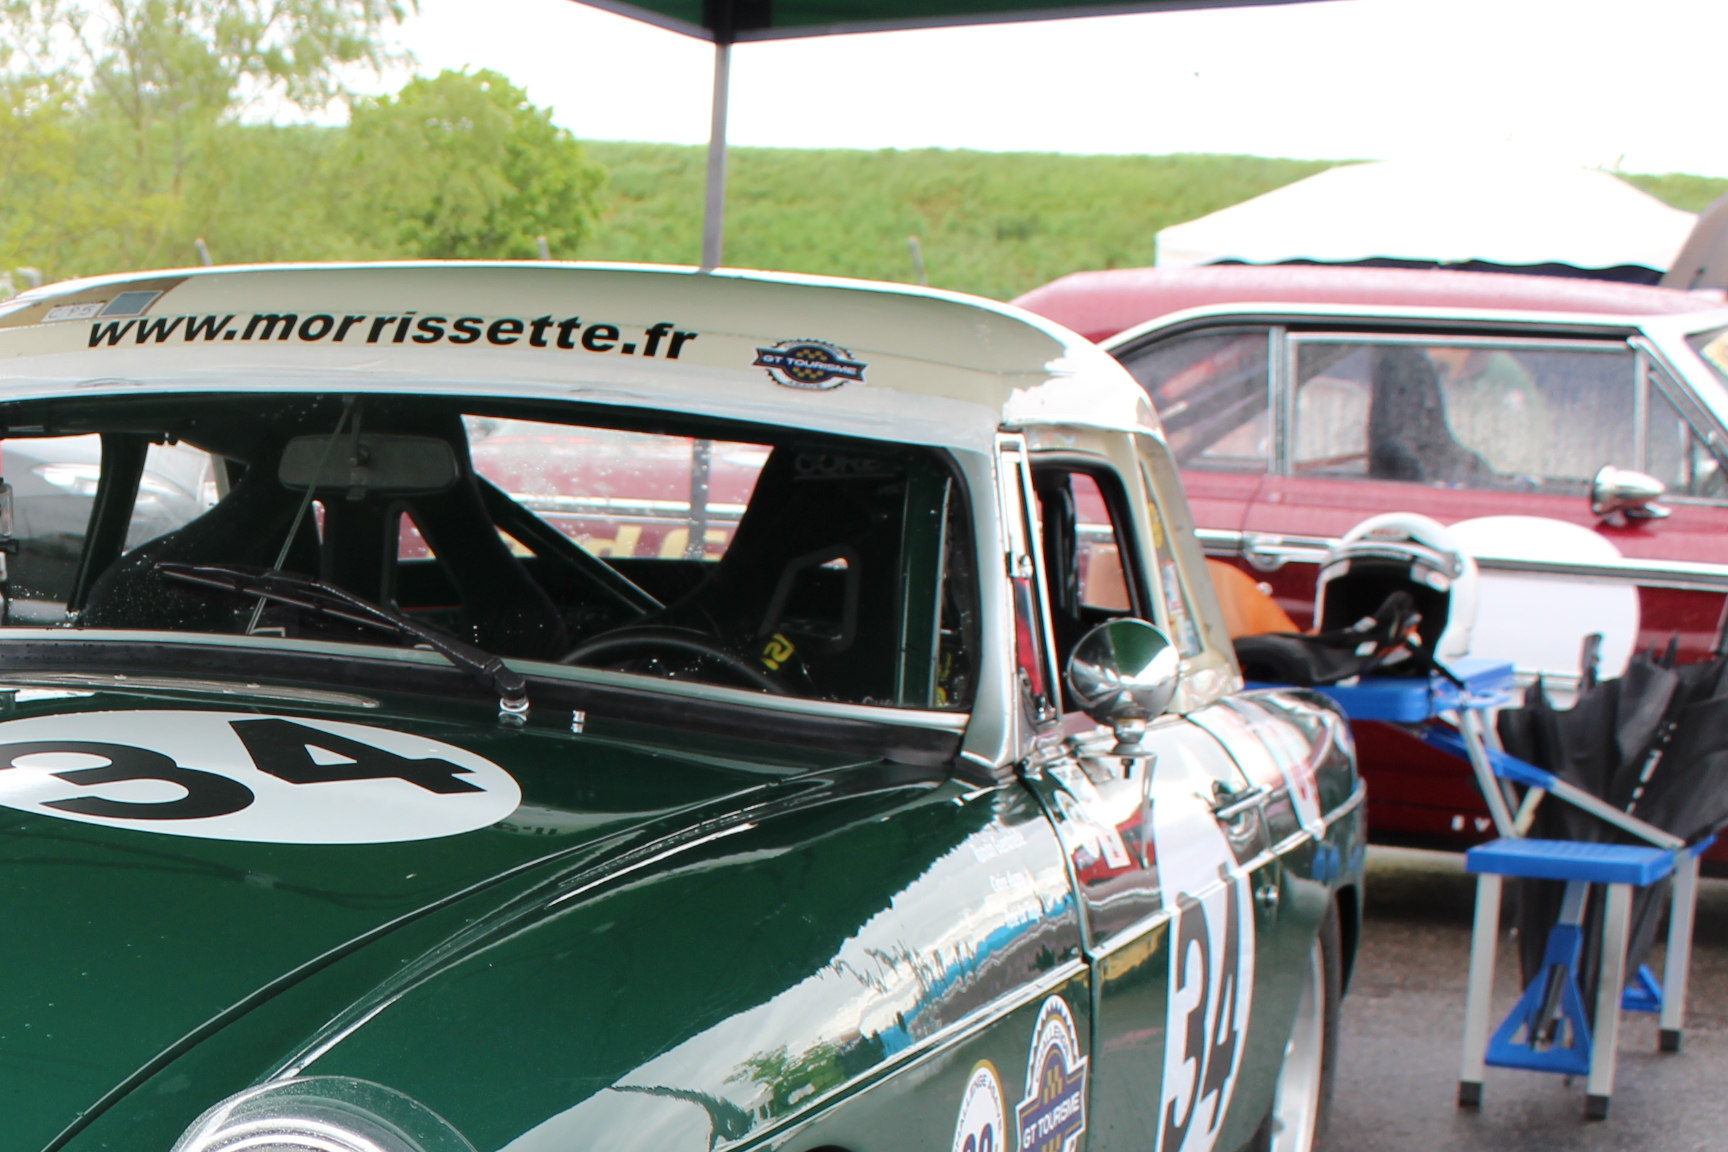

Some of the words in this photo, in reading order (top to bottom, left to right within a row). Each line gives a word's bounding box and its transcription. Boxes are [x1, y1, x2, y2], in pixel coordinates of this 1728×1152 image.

[87, 313, 699, 359] www.morrissette.fr
[762, 354, 784, 364] GT
[785, 357, 858, 375] TOURISME
[1022, 1122, 1038, 1149] GT
